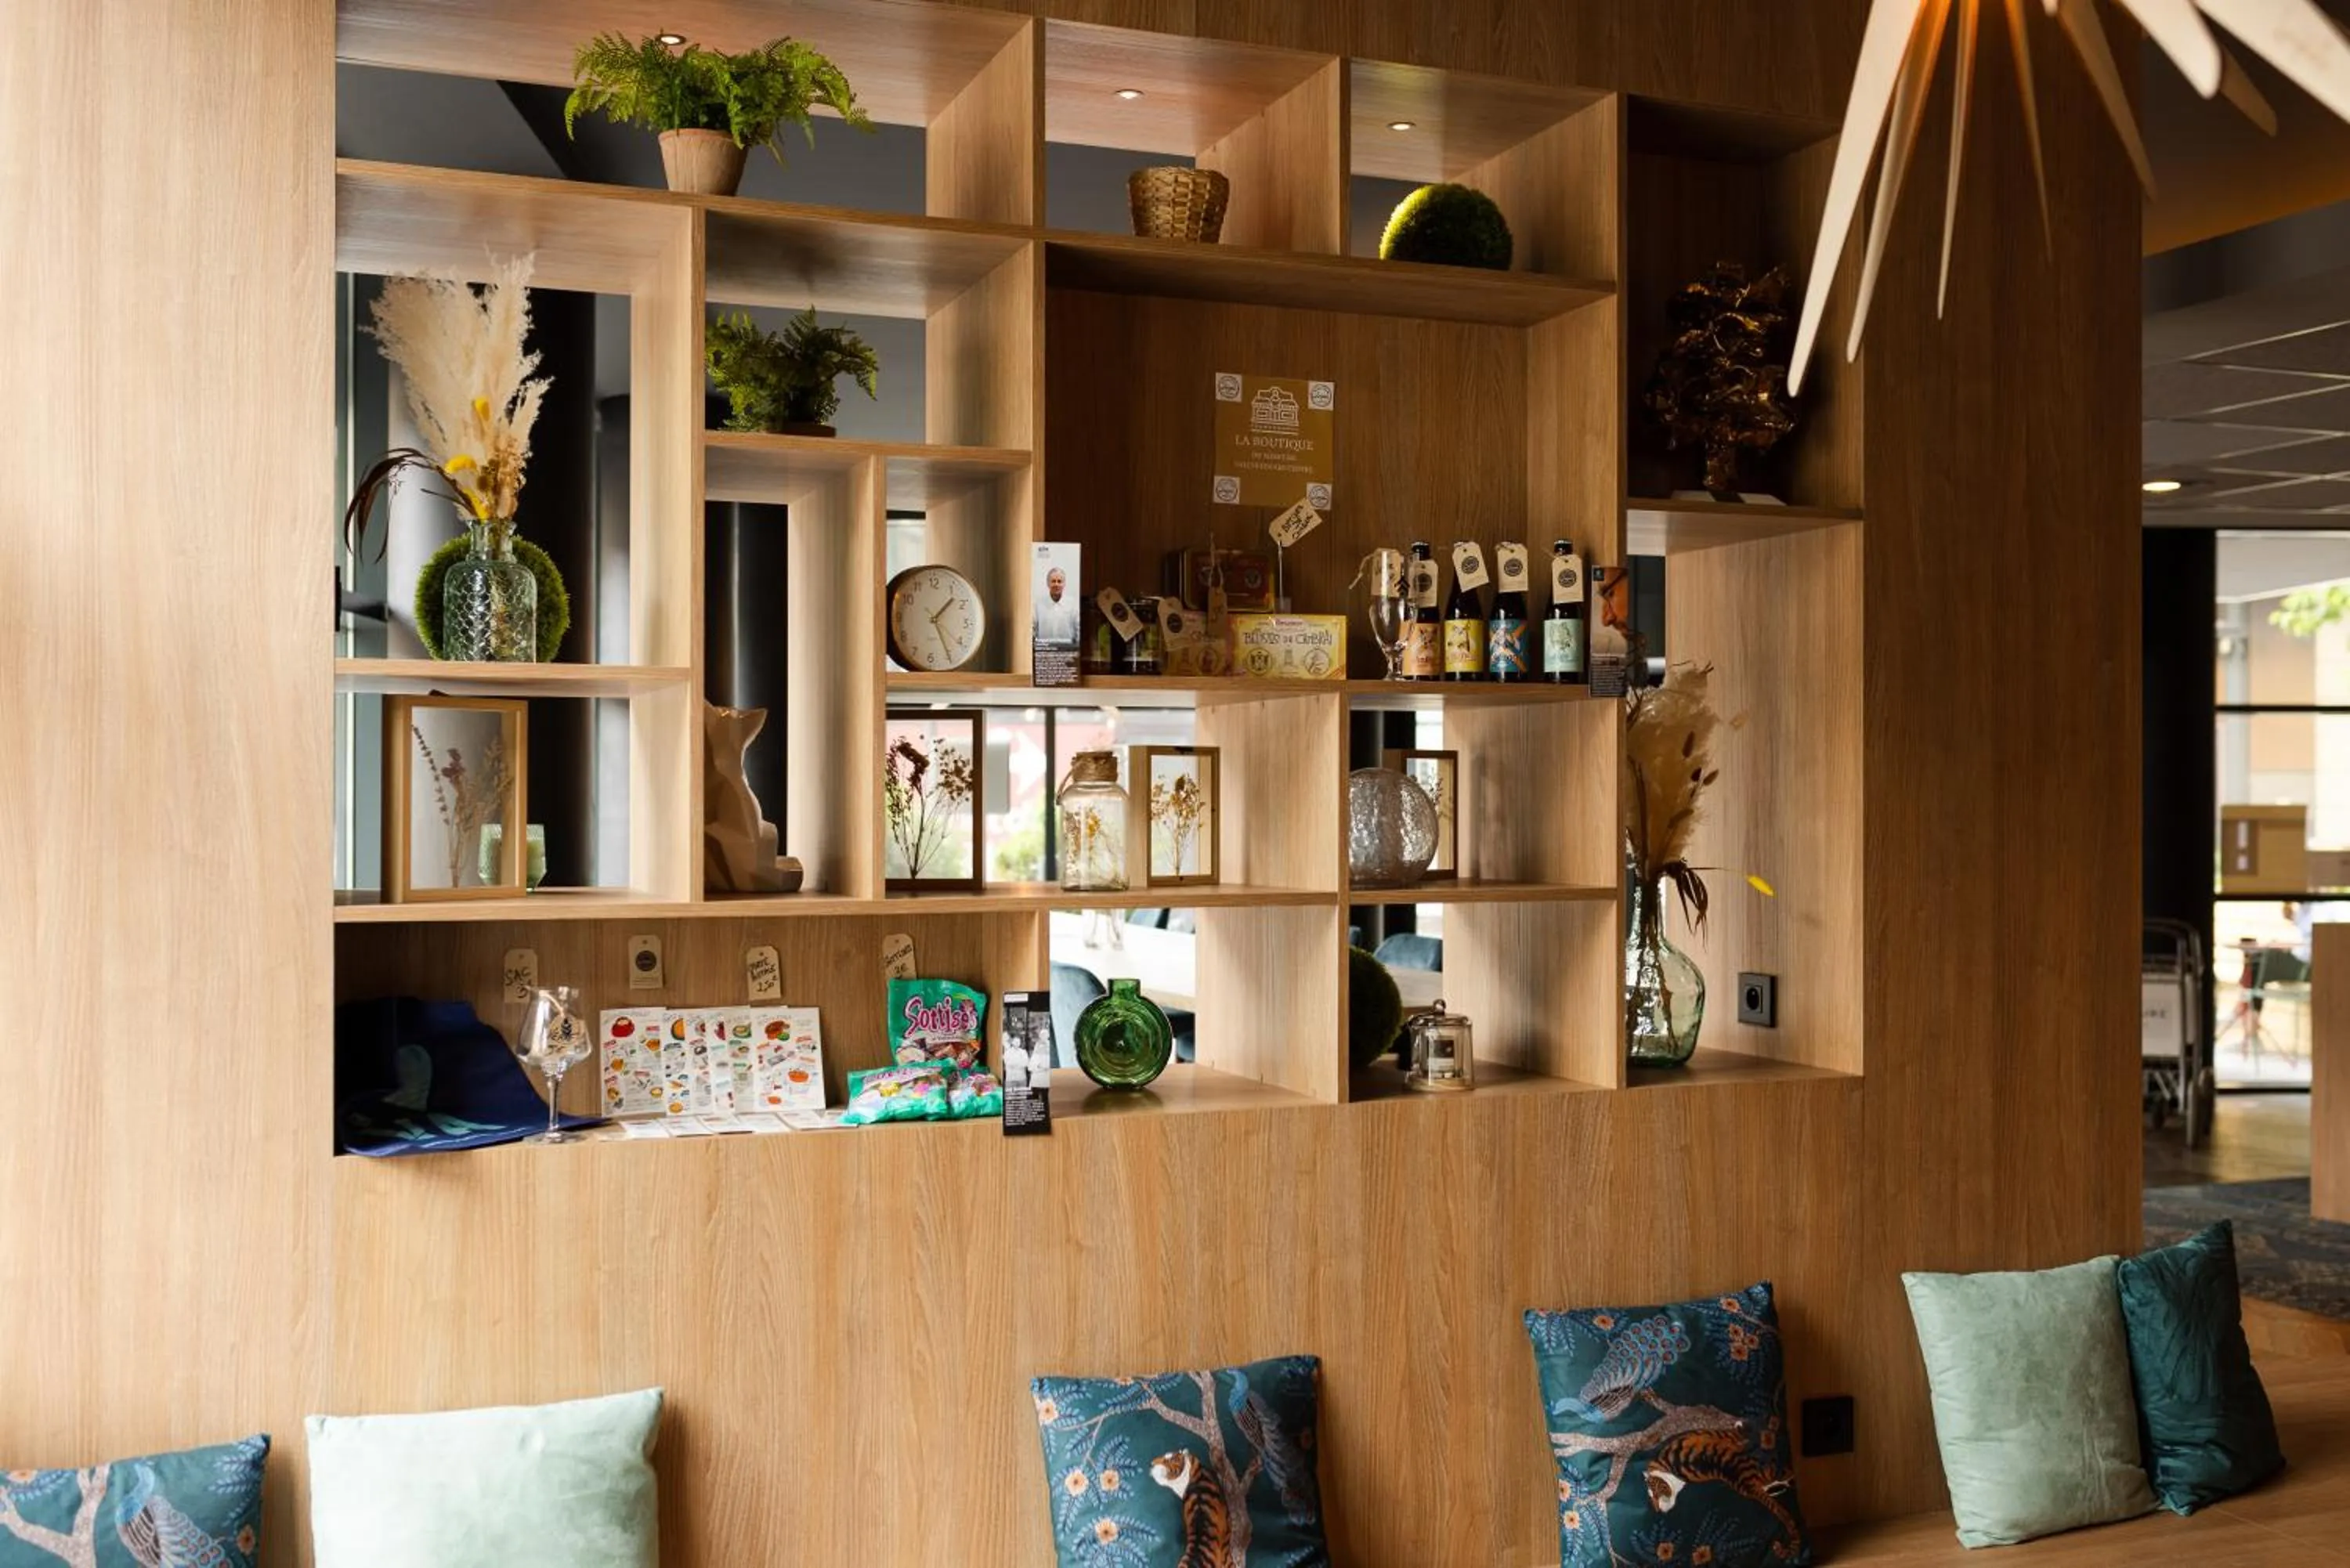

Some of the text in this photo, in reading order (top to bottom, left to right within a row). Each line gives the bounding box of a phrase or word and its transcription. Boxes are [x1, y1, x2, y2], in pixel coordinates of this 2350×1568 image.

[1235, 435, 1314, 452] LA BOUTIQUE
[929, 577, 939, 590] 12
[505, 966, 531, 986] SAC
